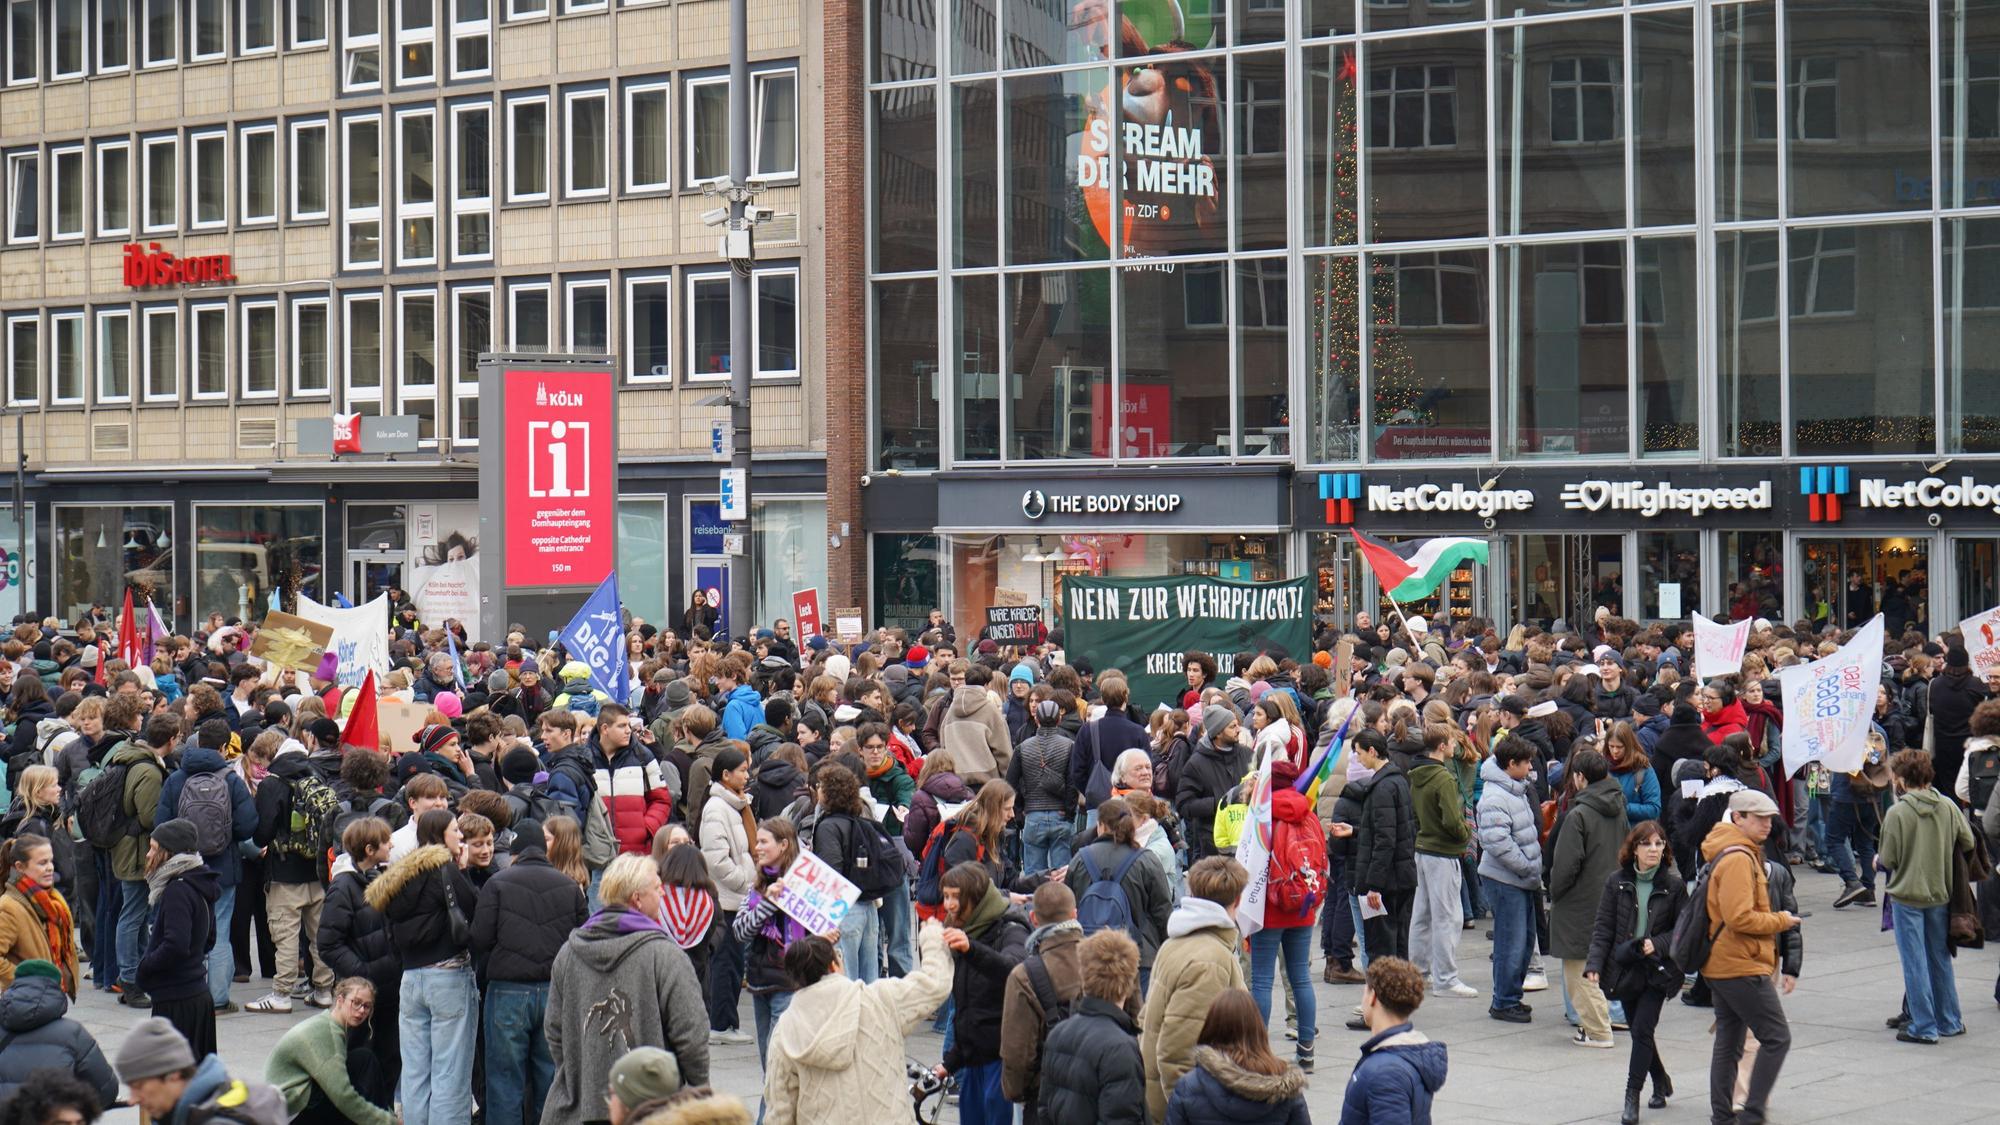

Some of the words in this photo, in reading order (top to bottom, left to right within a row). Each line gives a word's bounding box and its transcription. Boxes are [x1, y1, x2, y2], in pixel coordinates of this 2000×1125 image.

[1090, 119, 1201, 160] SREAM
[1137, 160, 1214, 196] MEHR
[1138, 204, 1158, 219] ZDF
[123, 242, 174, 287] ibis
[172, 254, 238, 284] HOTEL
[549, 390, 583, 406] KÖLN
[333, 424, 352, 440] ibis
[376, 431, 388, 440] Köln
[396, 430, 409, 438] Dom
[1051, 495, 1082, 512] THE
[1087, 495, 1131, 512] BODY
[1134, 494, 1181, 512] SHOP
[1368, 483, 1534, 517] NetCologne
[1611, 480, 1771, 517] Highspeed
[536, 508, 571, 519] gegenüber
[571, 508, 586, 516] dem
[531, 519, 591, 528] Domhaupteingang
[694, 524, 733, 535] reisebank
[531, 537, 559, 546] opposite
[560, 535, 591, 543] Cathedral
[539, 544, 555, 552] main
[552, 564, 564, 572] 150
[1070, 587, 1120, 621] NEIN
[1128, 586, 1169, 621] ZUR
[1176, 584, 1304, 621] WEHRPFLICHT!
[990, 608, 1010, 622] IHRE
[1010, 607, 1037, 621] KRIEGE
[990, 623, 1015, 640] UNSER
[1015, 622, 1035, 639] BLUT
[1146, 652, 1184, 675] KRIEG
[1217, 652, 1236, 674] KRI
[1816, 674, 1841, 719] eace
